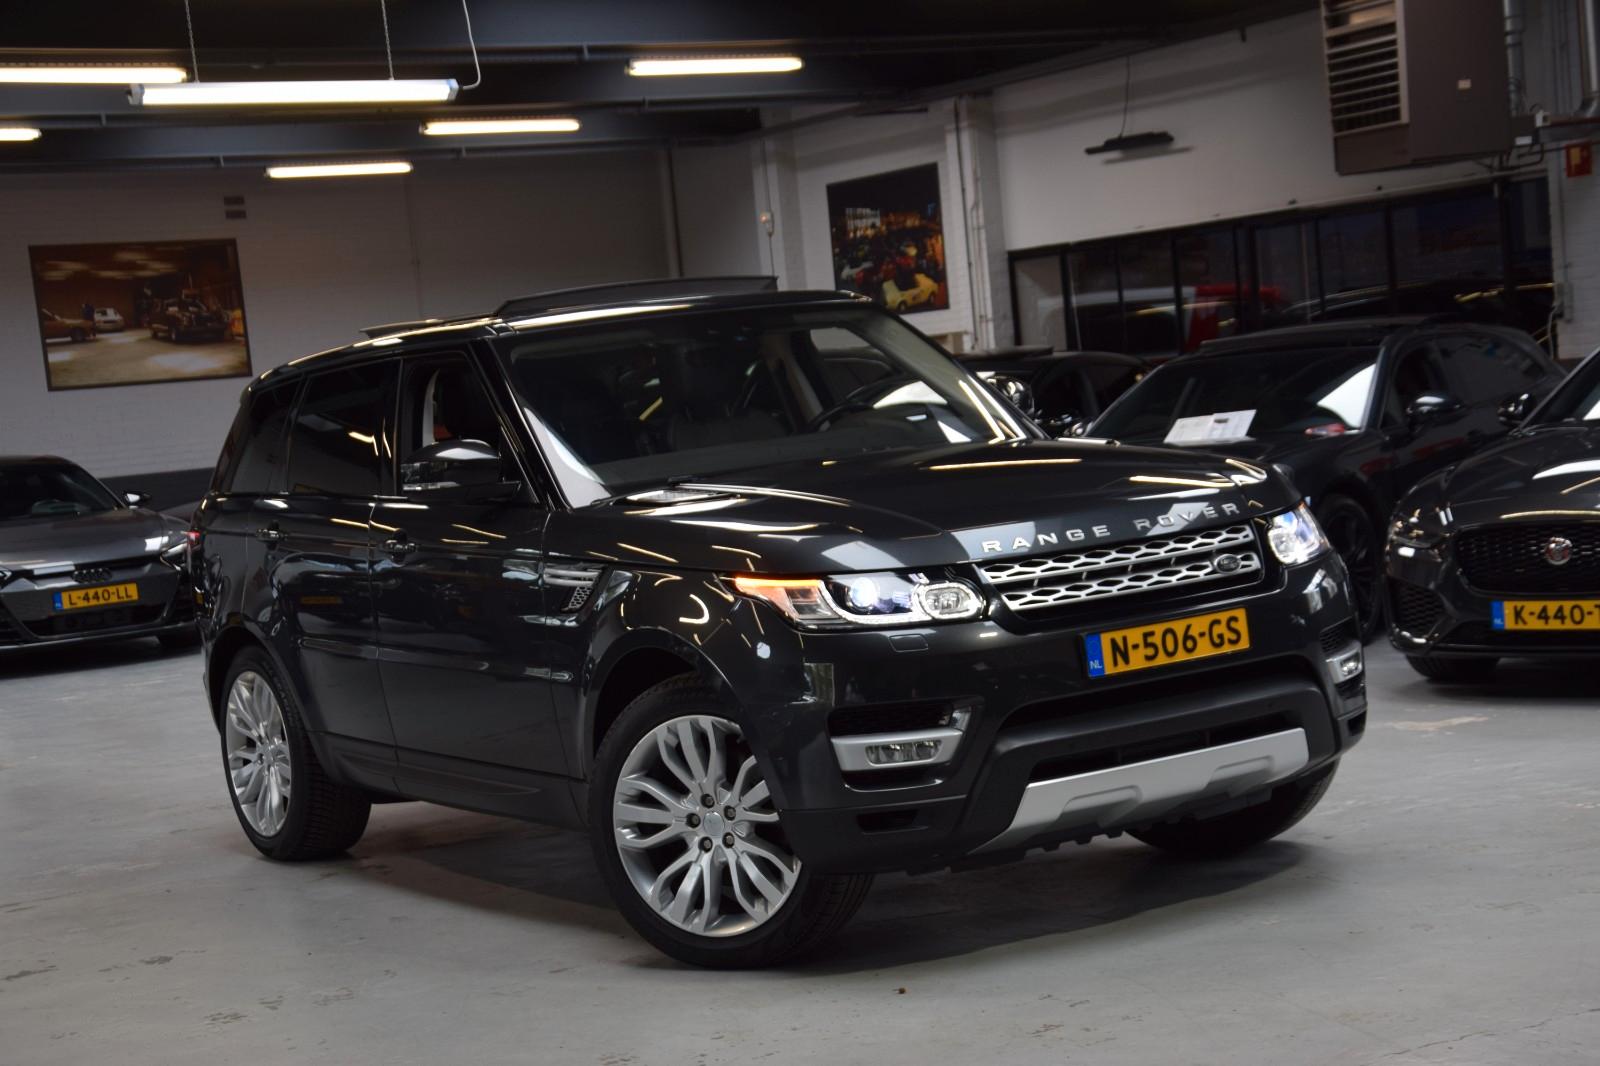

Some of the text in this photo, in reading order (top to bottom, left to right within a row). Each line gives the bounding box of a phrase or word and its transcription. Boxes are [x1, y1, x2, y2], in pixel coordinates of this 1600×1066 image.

[982, 502, 1240, 553] RANGE ROVER
[68, 585, 133, 606] L-440-LL
[1090, 615, 1242, 670] NL N-506-GS
